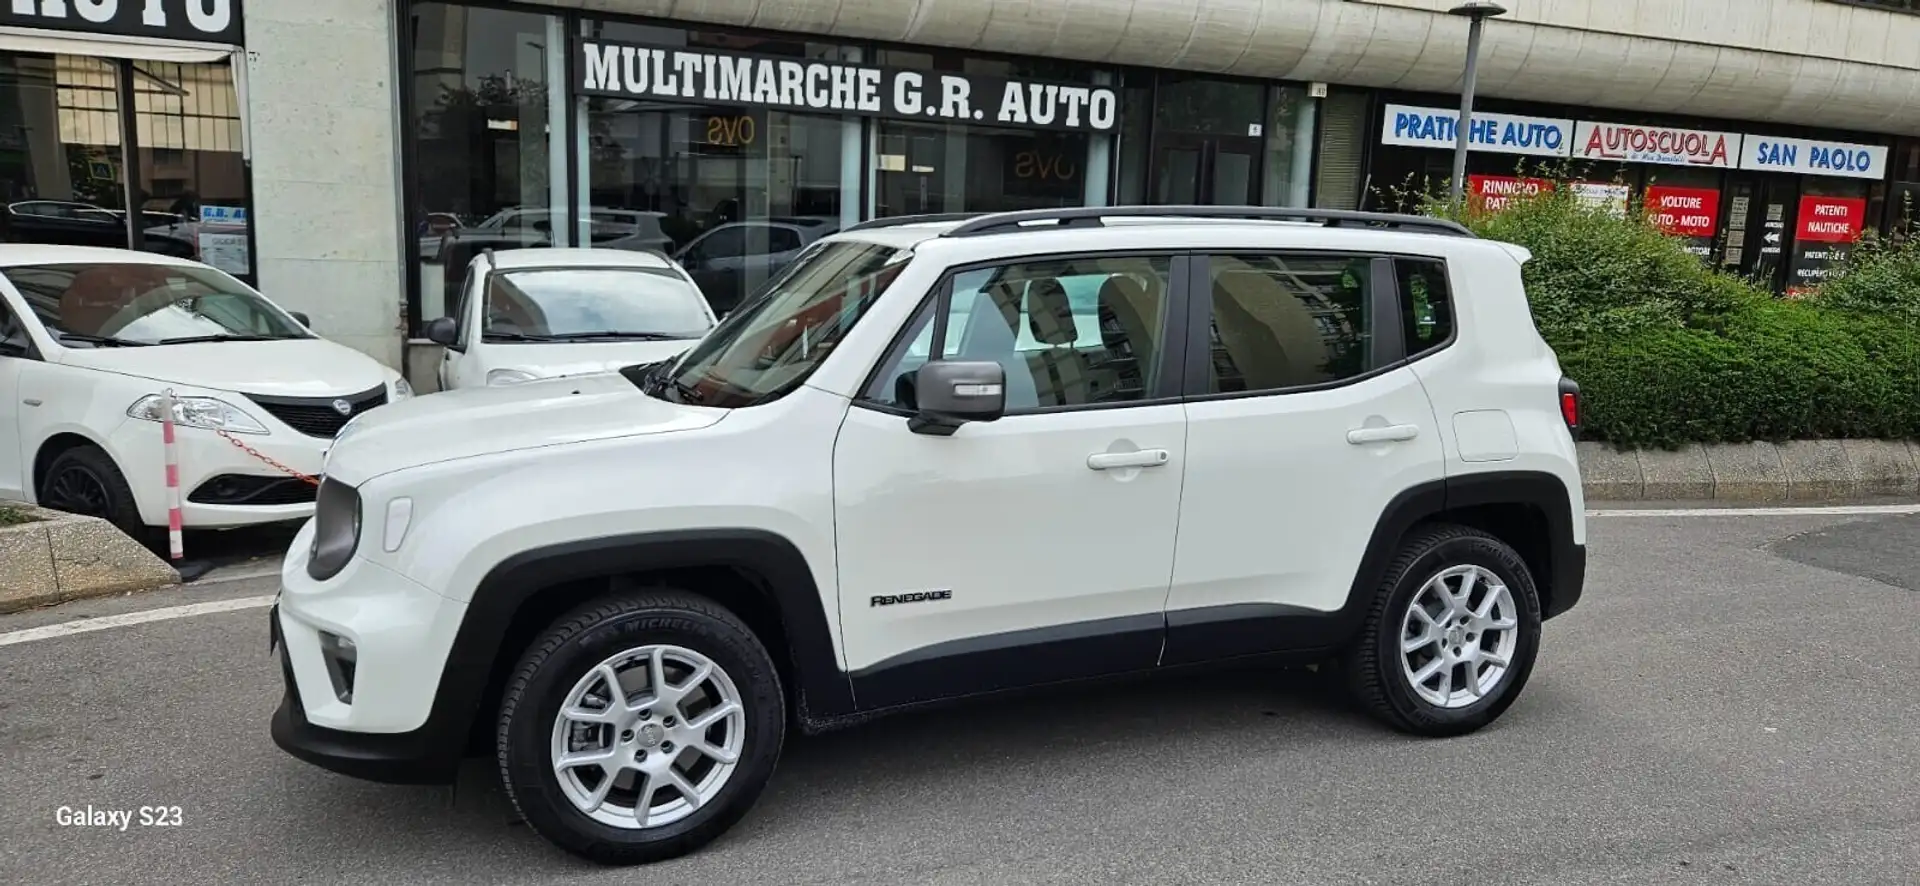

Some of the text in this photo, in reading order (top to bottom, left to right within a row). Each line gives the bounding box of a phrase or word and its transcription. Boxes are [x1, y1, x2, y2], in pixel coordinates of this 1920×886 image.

[583, 43, 1117, 130] MULTIMARCHE G.R. AUTO
[1501, 121, 1563, 149] AUTO
[1584, 124, 1729, 167] AUTOSCUOLA
[1757, 142, 1871, 173] SAN PAOLO
[1660, 195, 1702, 209] VOLTURE
[1814, 204, 1849, 217] PATENTI
[1680, 214, 1710, 228] MOTO
[1807, 221, 1850, 234] NAUTICHE
[869, 589, 952, 607] RENEGADE
